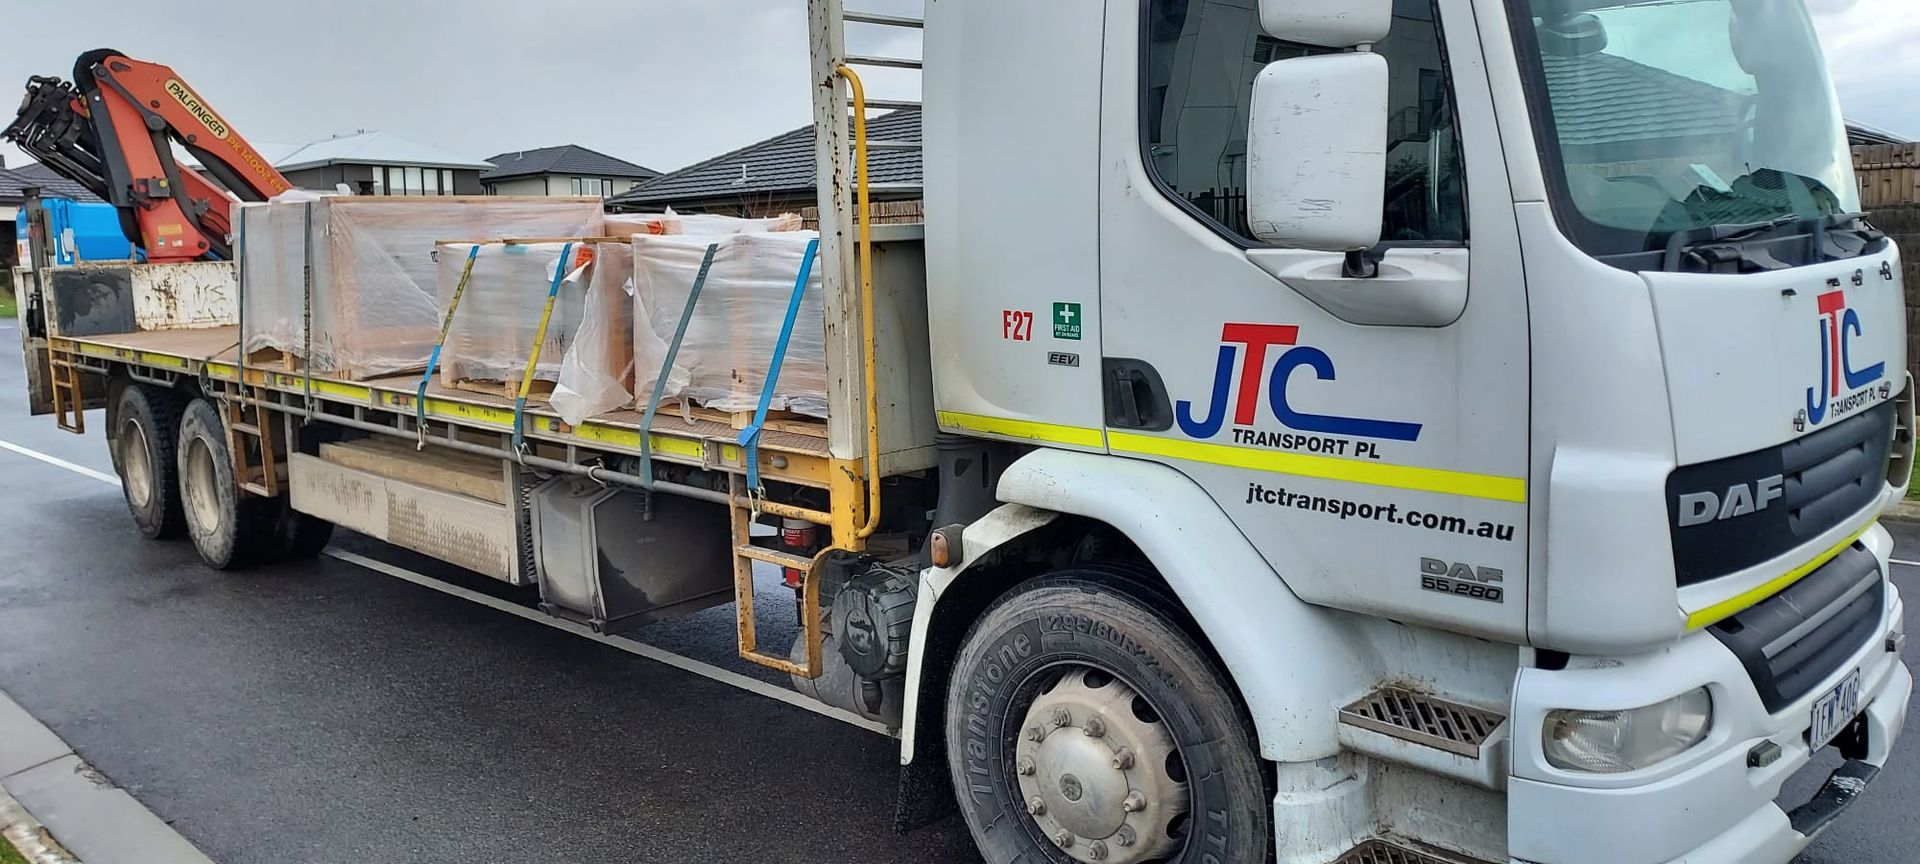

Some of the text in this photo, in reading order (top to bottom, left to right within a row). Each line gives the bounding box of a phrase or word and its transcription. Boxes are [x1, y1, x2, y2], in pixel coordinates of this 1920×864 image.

[168, 82, 225, 136] PALFINGER
[226, 136, 241, 151] PK
[1003, 310, 1033, 341] F27
[1054, 323, 1080, 332] FIRST AID
[1049, 353, 1076, 364] EEV
[1806, 290, 1886, 425] JTC
[1176, 322, 1423, 442] JTC
[1830, 387, 1876, 419] TRANSPORT PL
[1232, 428, 1381, 459] TRANSPORT PL
[1246, 482, 1515, 541] jtctransport.com.au
[1678, 474, 1783, 527] DAF
[1420, 556, 1503, 583] DAF
[1421, 576, 1501, 600] 55.280
